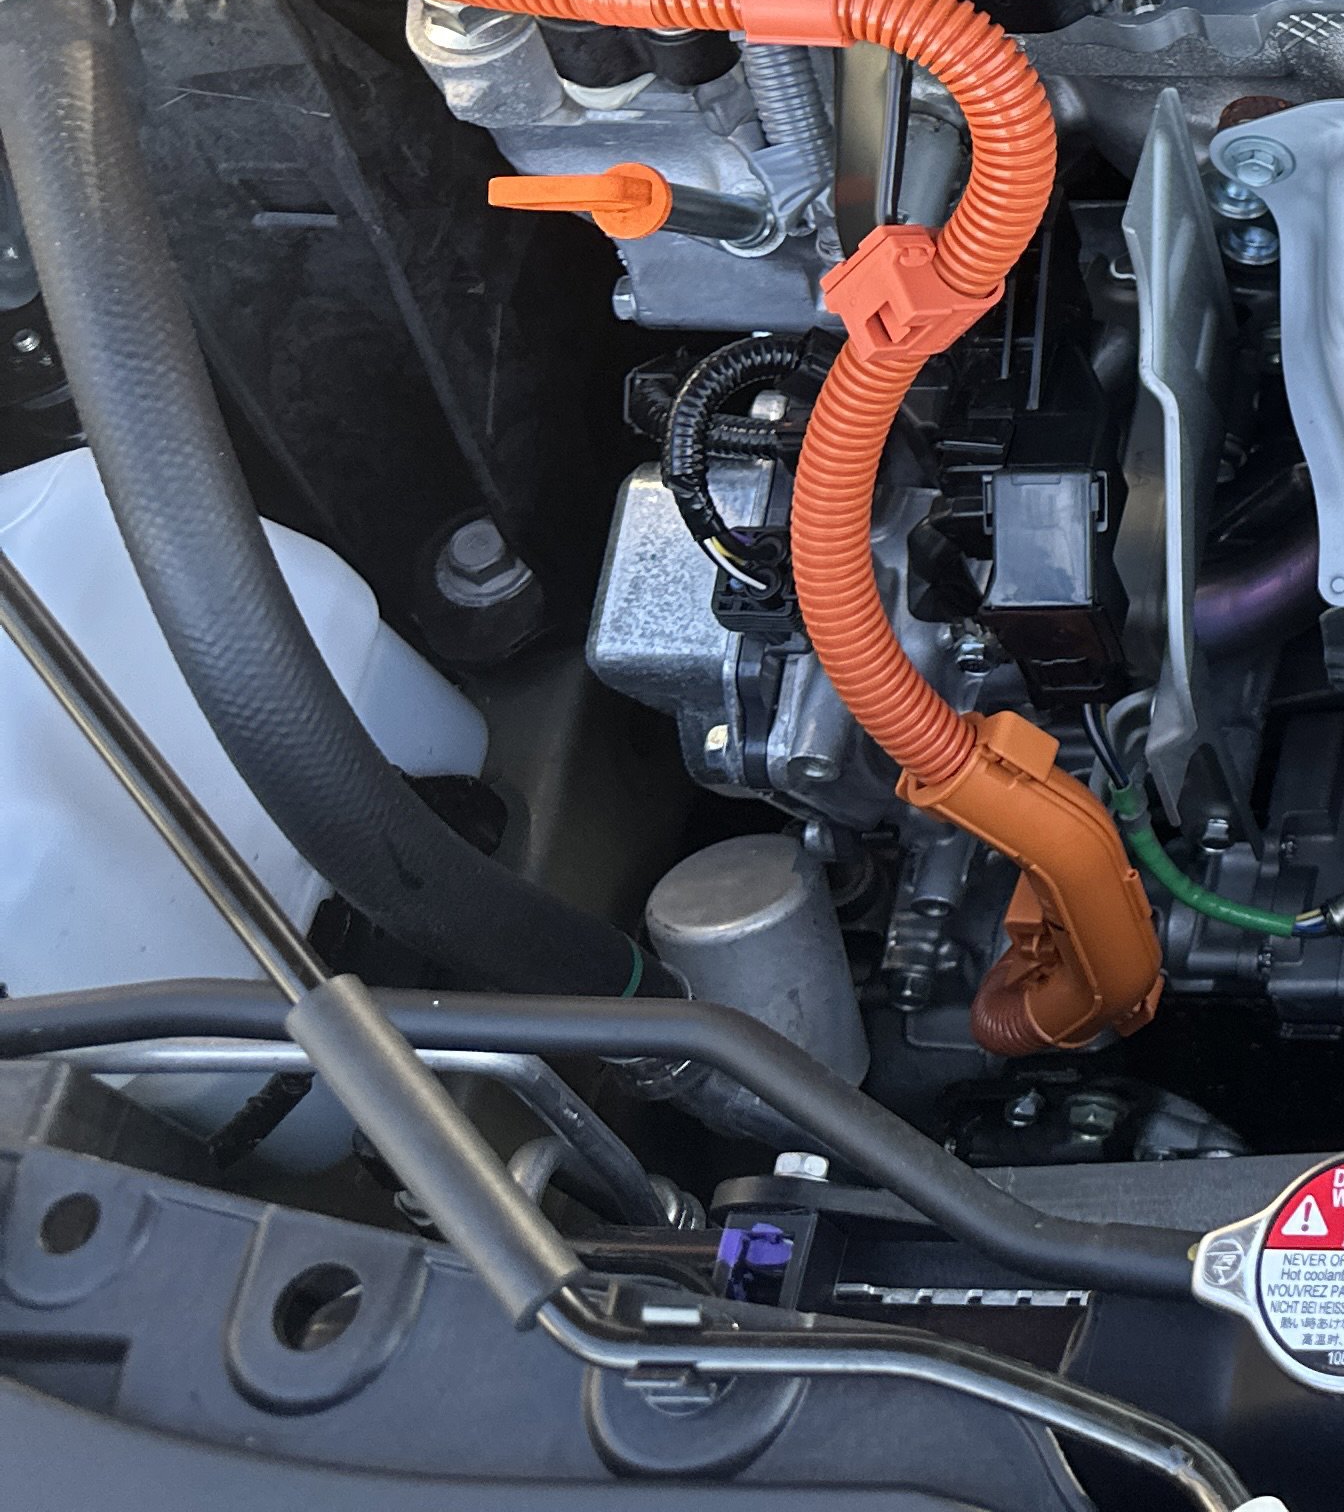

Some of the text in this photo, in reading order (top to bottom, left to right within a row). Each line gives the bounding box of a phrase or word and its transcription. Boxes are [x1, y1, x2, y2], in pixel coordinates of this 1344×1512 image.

[1282, 1253, 1327, 1267] NEVER
[1281, 1269, 1301, 1282] Hot
[1267, 1283, 1328, 1298] N'OUVREZ
[1270, 1301, 1300, 1314] NICHT
[1300, 1301, 1317, 1315] BEI
